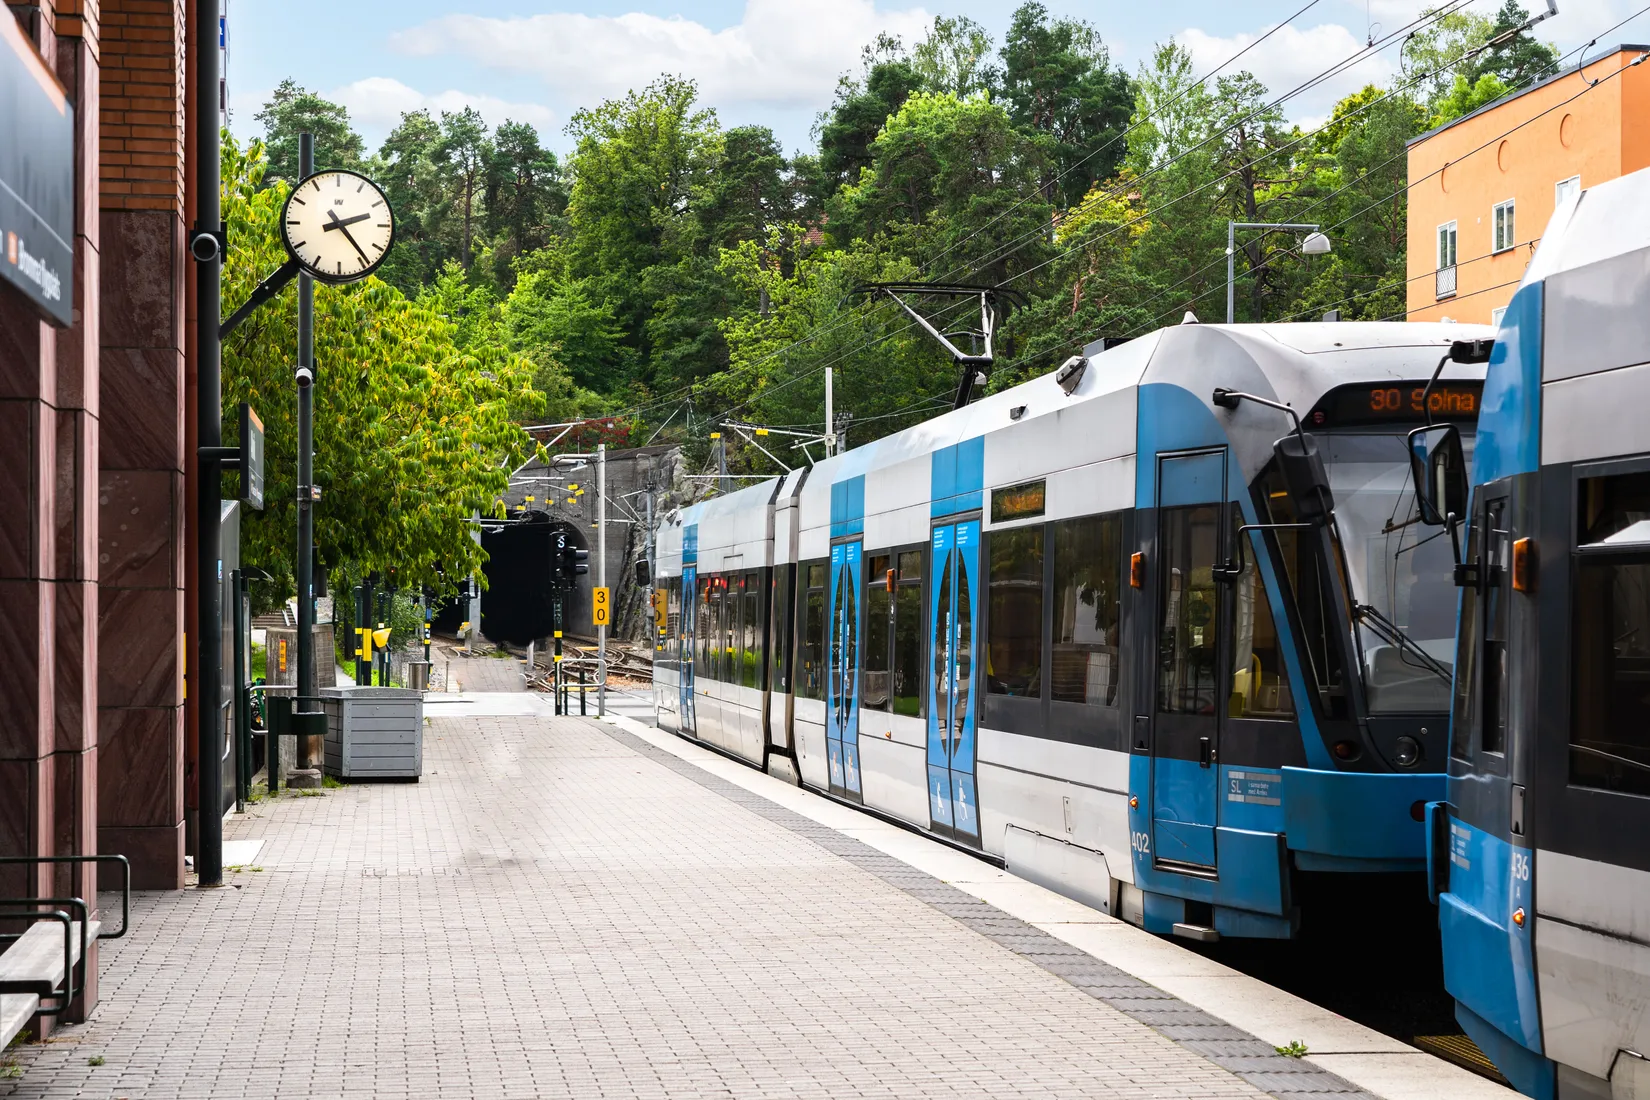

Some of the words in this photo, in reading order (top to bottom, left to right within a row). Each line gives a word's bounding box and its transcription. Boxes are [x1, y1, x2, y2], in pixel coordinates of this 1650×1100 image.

[1370, 388, 1400, 411] 30
[1411, 388, 1475, 411] Solna
[1230, 779, 1241, 793] SL
[1131, 831, 1150, 853] 402
[1516, 885, 1521, 900] A
